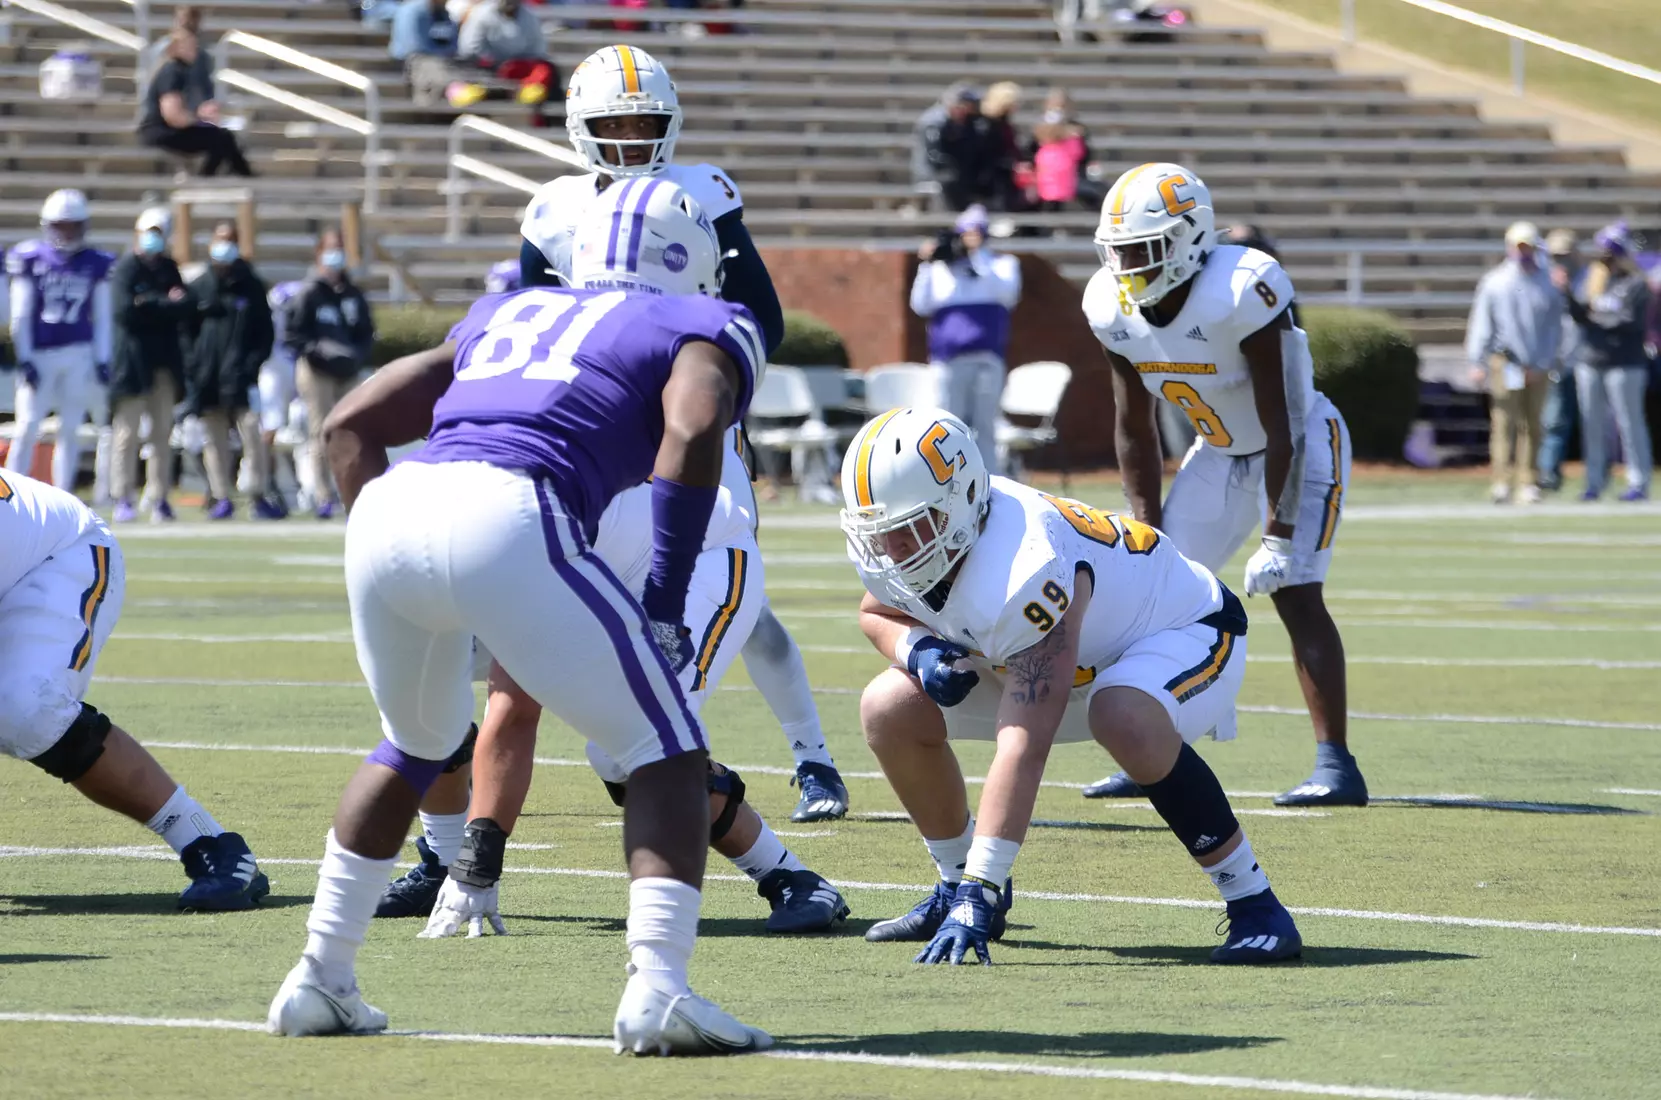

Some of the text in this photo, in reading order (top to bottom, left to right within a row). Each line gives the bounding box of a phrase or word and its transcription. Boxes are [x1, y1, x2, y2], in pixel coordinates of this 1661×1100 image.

[711, 174, 735, 200] 3
[1157, 174, 1197, 217] C
[616, 279, 636, 291] THE
[1253, 280, 1278, 309] 8
[455, 289, 626, 385] 81
[1160, 379, 1234, 449] 8
[917, 419, 968, 486] C
[1022, 579, 1070, 633] 99
